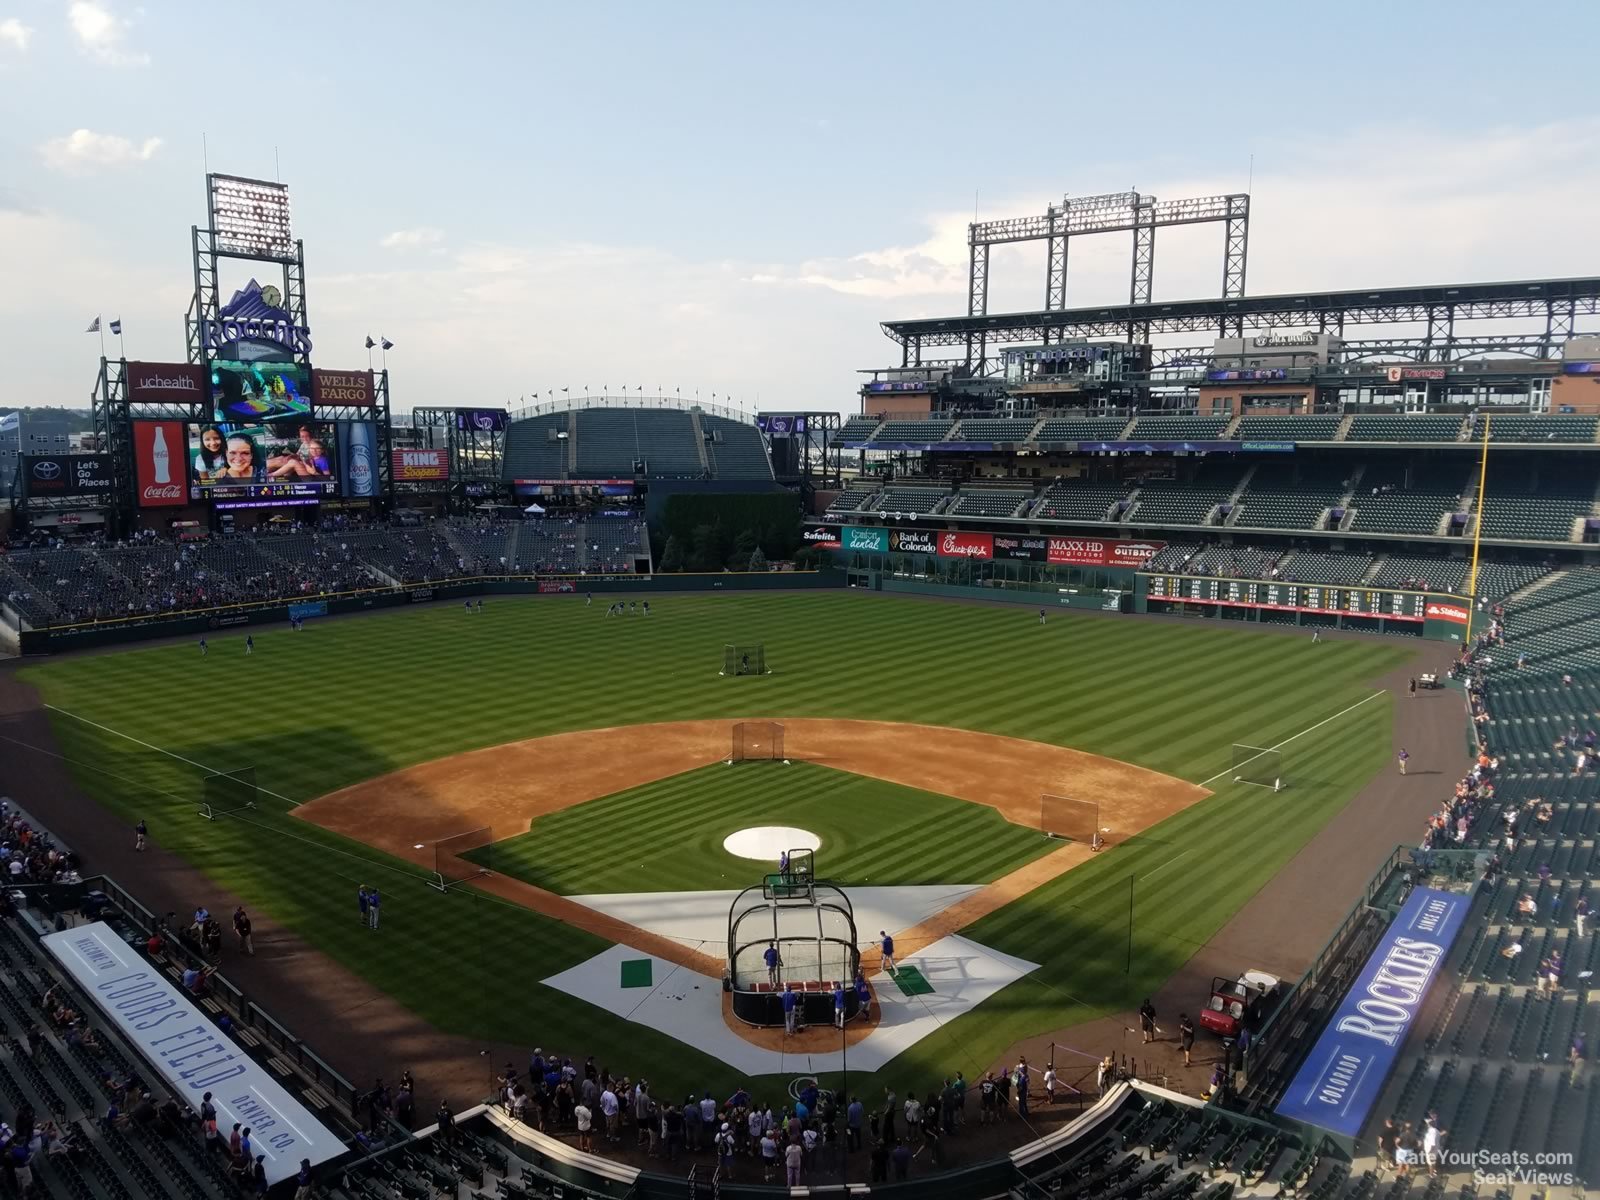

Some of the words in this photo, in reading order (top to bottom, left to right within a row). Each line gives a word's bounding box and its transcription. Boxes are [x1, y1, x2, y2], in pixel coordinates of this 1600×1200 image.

[202, 320, 313, 355] ROCKIES
[140, 374, 195, 389] uchealth
[318, 375, 366, 388] WELLS
[320, 388, 366, 401] FARGO
[1241, 442, 1294, 451] OfficeLiquidators.com
[77, 460, 99, 470] Let's
[402, 452, 439, 466] KING
[77, 470, 91, 478] Go
[78, 478, 110, 487] Places
[804, 531, 836, 541] Safelite
[900, 532, 920, 542] Bank
[921, 533, 929, 543] of
[849, 537, 880, 550] dental
[900, 541, 936, 552] Colorado
[1050, 540, 1083, 551] MAXX
[1086, 542, 1104, 551] HD
[1050, 549, 1103, 558] sunglasses
[1417, 912, 1440, 931] SINCE
[74, 937, 109, 963] WELCOME
[97, 960, 116, 970] TO
[1336, 936, 1444, 1046] ROCKIES
[97, 971, 189, 1031] COORS
[150, 1025, 247, 1090] FIELD
[1319, 1055, 1361, 1105] COLORADO
[270, 1133, 296, 1153] CO.
